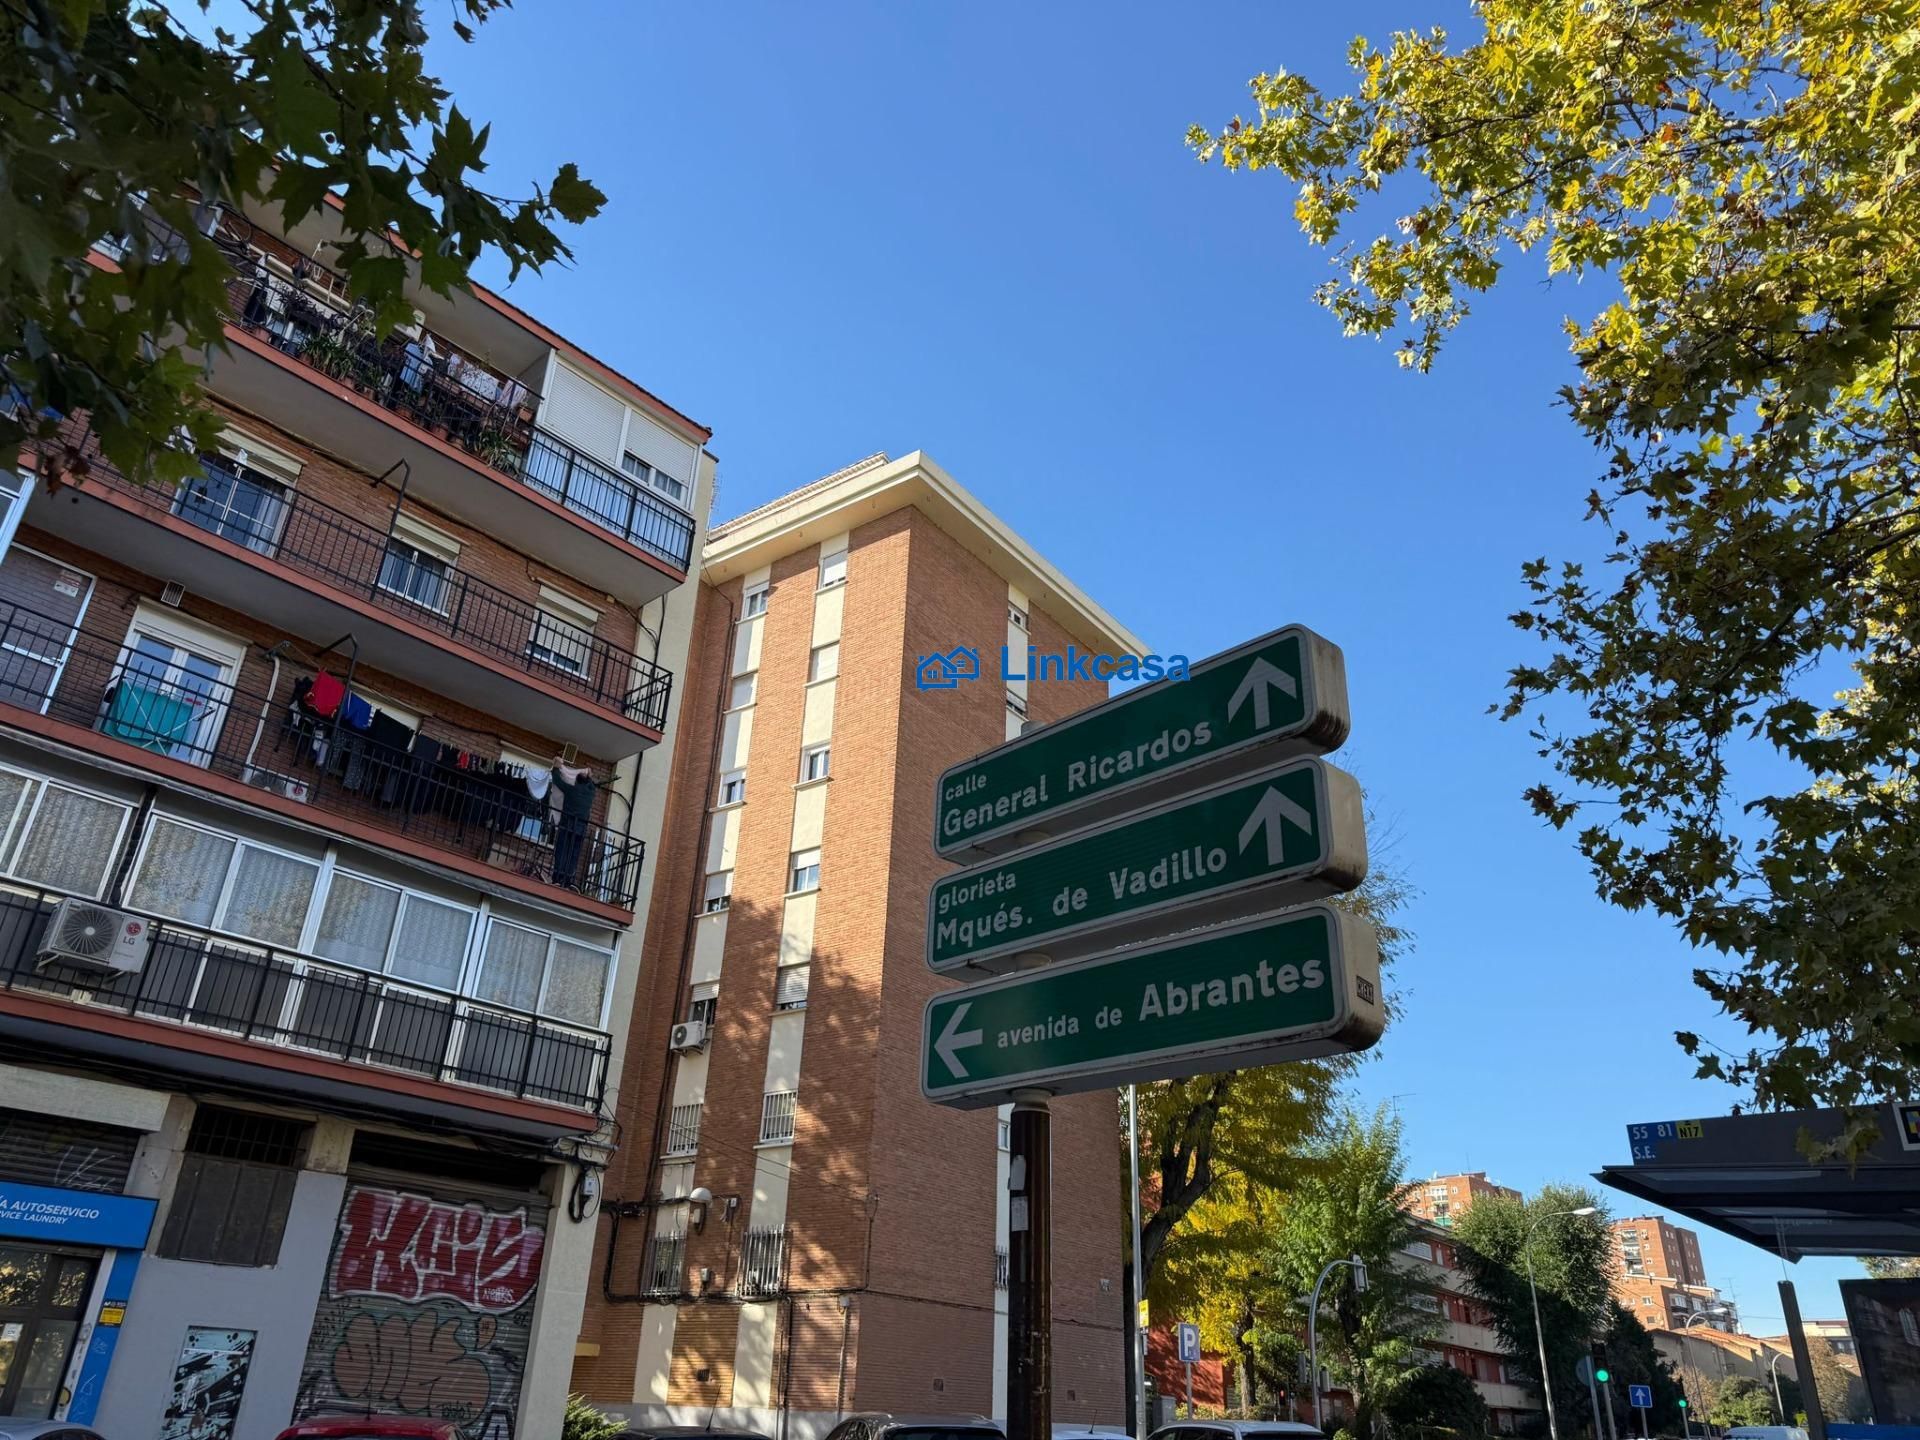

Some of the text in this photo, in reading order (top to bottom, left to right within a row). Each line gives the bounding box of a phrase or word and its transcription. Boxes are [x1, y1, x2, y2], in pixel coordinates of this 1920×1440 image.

[944, 720, 1212, 836] General Ricardos
[945, 772, 987, 801] calle
[936, 847, 1226, 951] Mqués. de Vadillo
[938, 870, 1016, 915] glorieta
[122, 936, 135, 946] LG
[997, 1013, 1079, 1049] avenida
[1094, 1005, 1122, 1029] de
[1139, 957, 1325, 1022] Abrantes
[1657, 1124, 1672, 1137] 81
[1633, 1145, 1656, 1159] S.E.
[10, 1200, 100, 1219] AUTOSERVICIO
[23, 1213, 69, 1225] LAUNDRY
[1183, 1327, 1196, 1357] P
